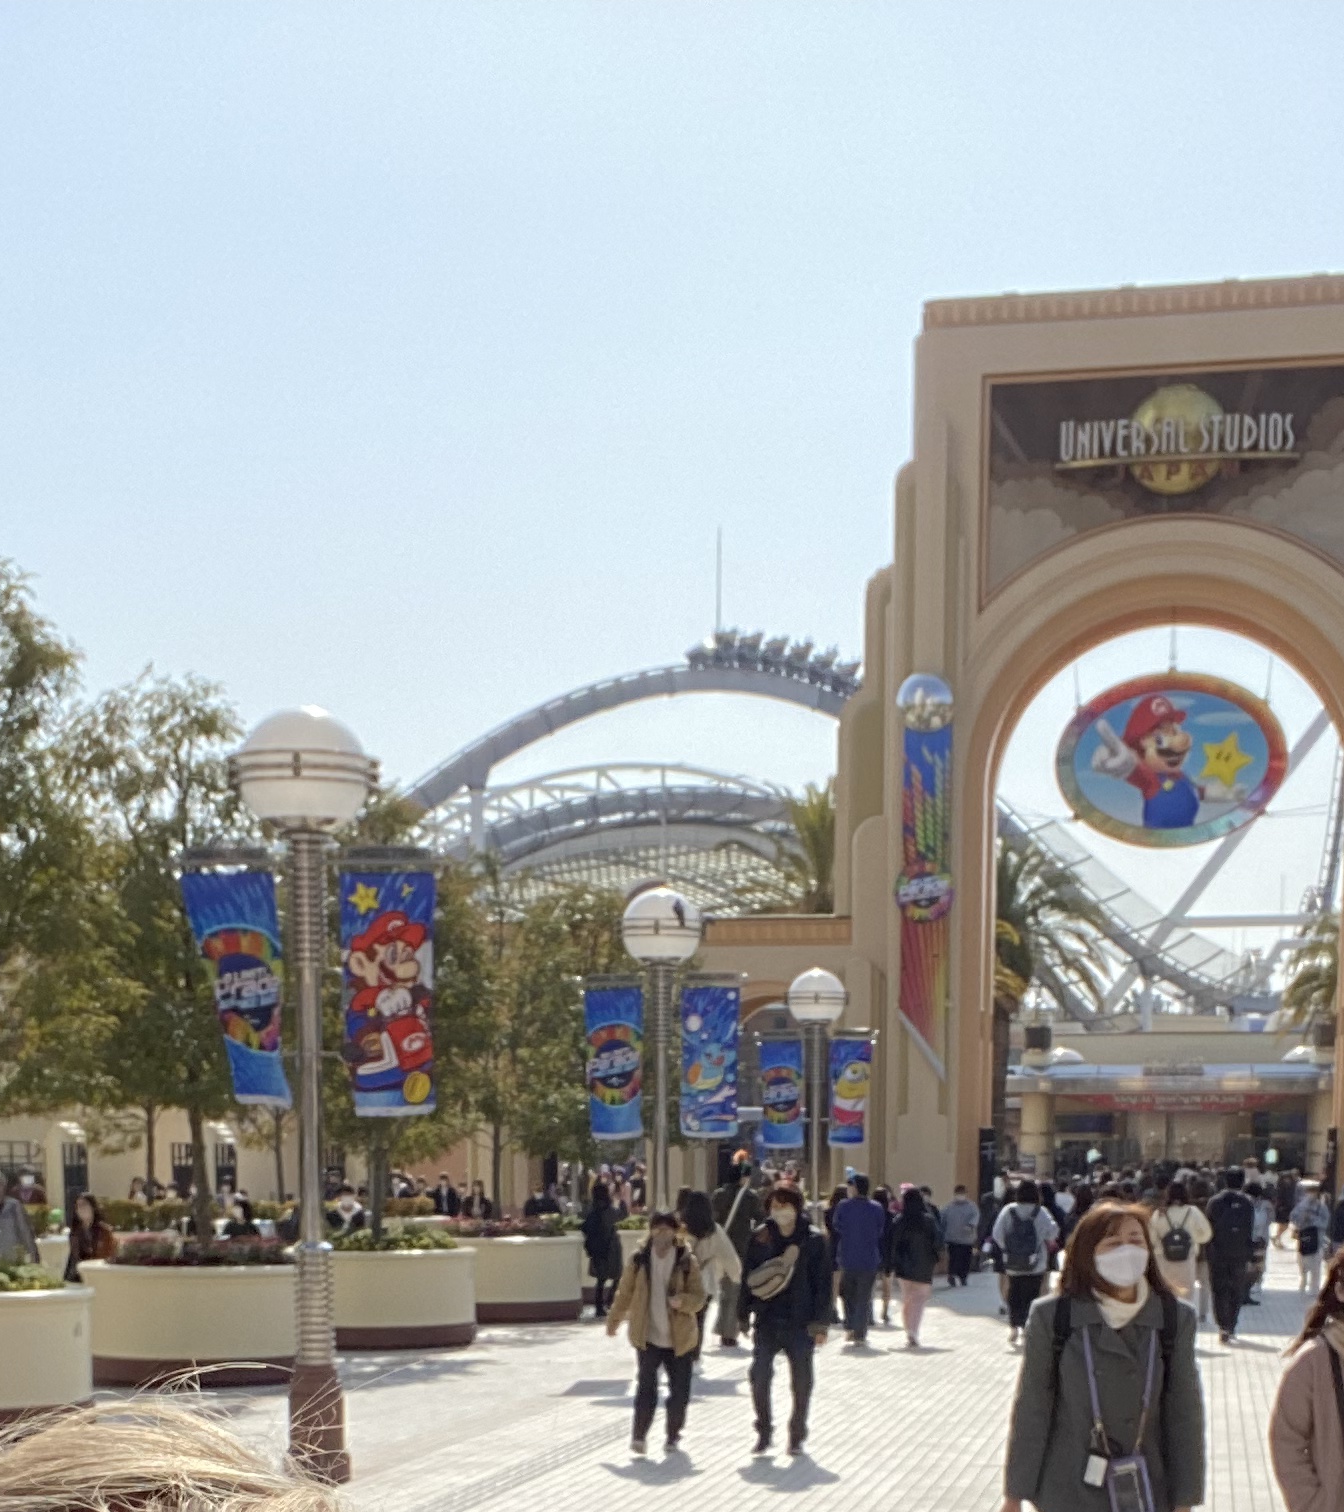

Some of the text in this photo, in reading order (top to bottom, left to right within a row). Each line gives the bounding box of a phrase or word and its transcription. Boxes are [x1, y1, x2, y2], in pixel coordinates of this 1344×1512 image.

[1060, 412, 1295, 461] UNIVERSAL STUDIOS
[1115, 460, 1241, 483] JAPAN
